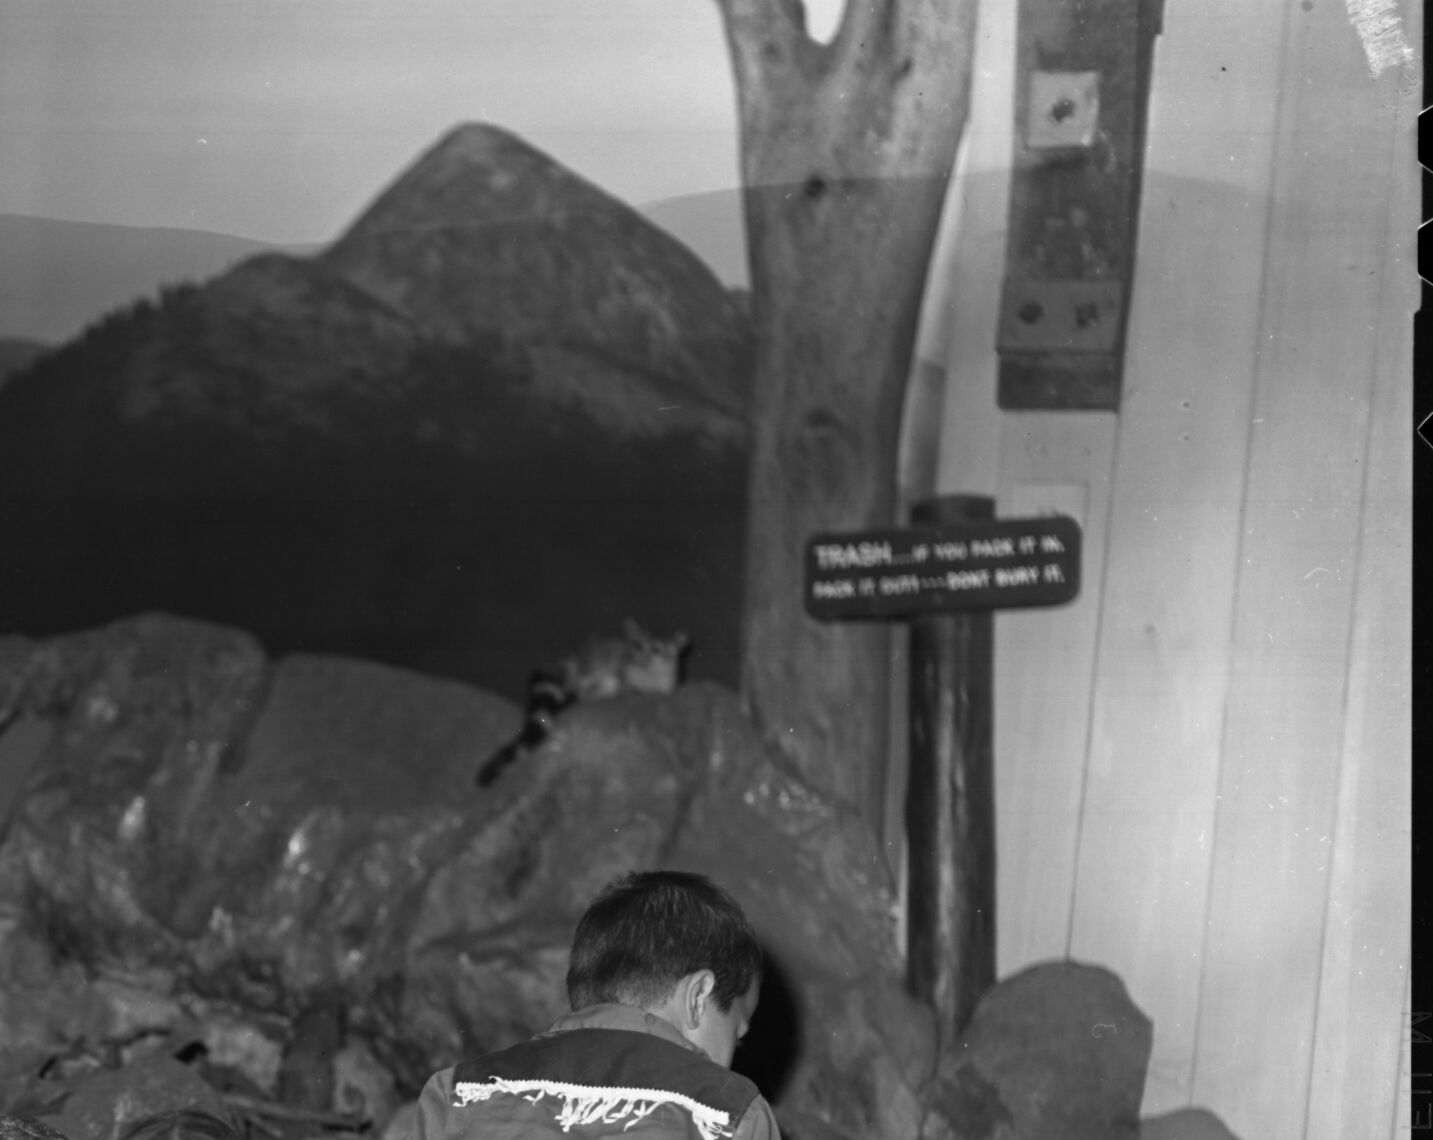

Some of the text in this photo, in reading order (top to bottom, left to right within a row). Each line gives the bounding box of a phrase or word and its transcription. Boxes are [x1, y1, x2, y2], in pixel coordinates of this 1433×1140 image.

[933, 542, 968, 561] YOU
[971, 538, 1015, 559] PACK
[1019, 535, 1037, 556] IT
[813, 579, 855, 600] PACK
[858, 576, 876, 597] IT
[994, 563, 1040, 589] BURY
